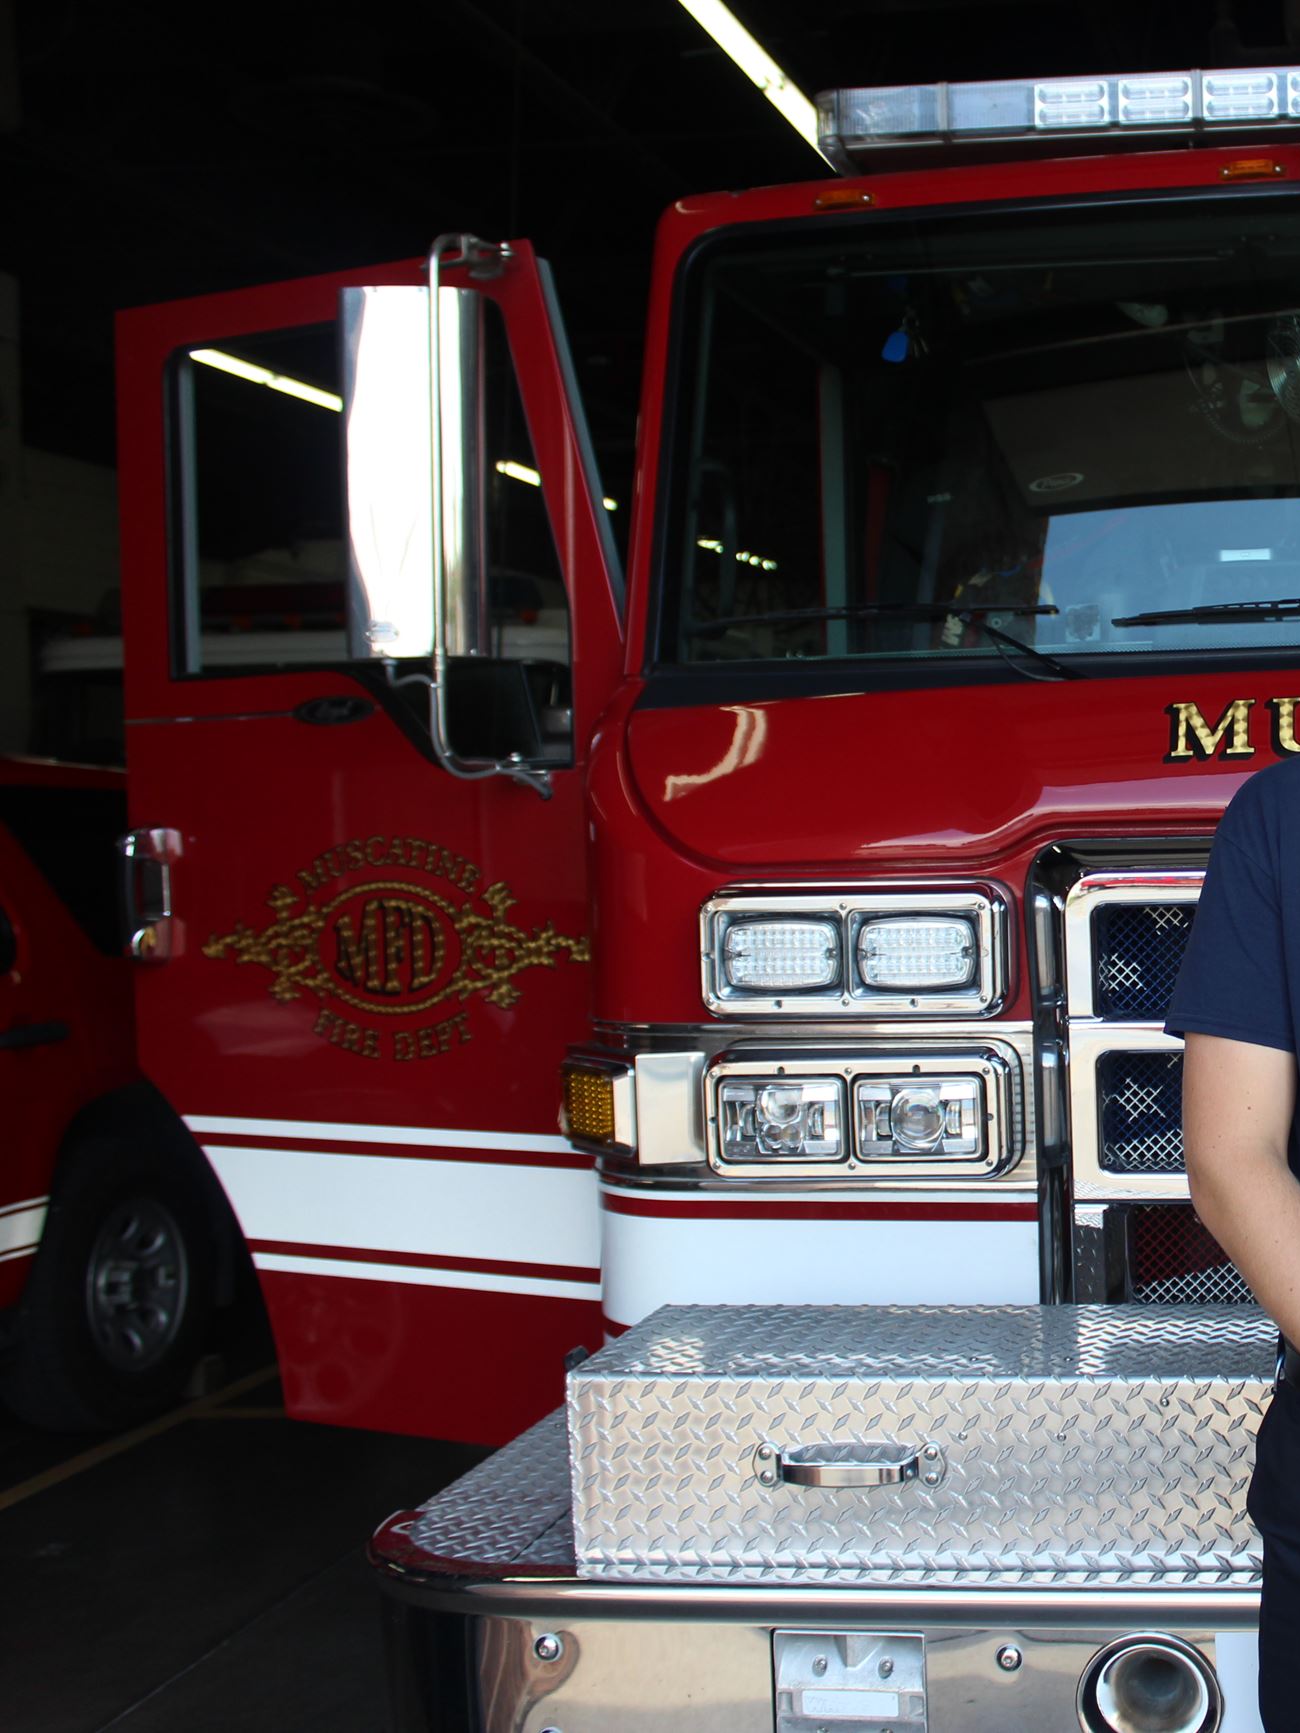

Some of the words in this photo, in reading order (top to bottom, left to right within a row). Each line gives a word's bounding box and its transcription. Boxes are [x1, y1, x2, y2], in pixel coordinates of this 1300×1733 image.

[297, 834, 481, 893] MUSCATINE
[335, 898, 446, 994] MFD
[313, 1007, 382, 1060] FIRE
[393, 1010, 475, 1062] DEPT
